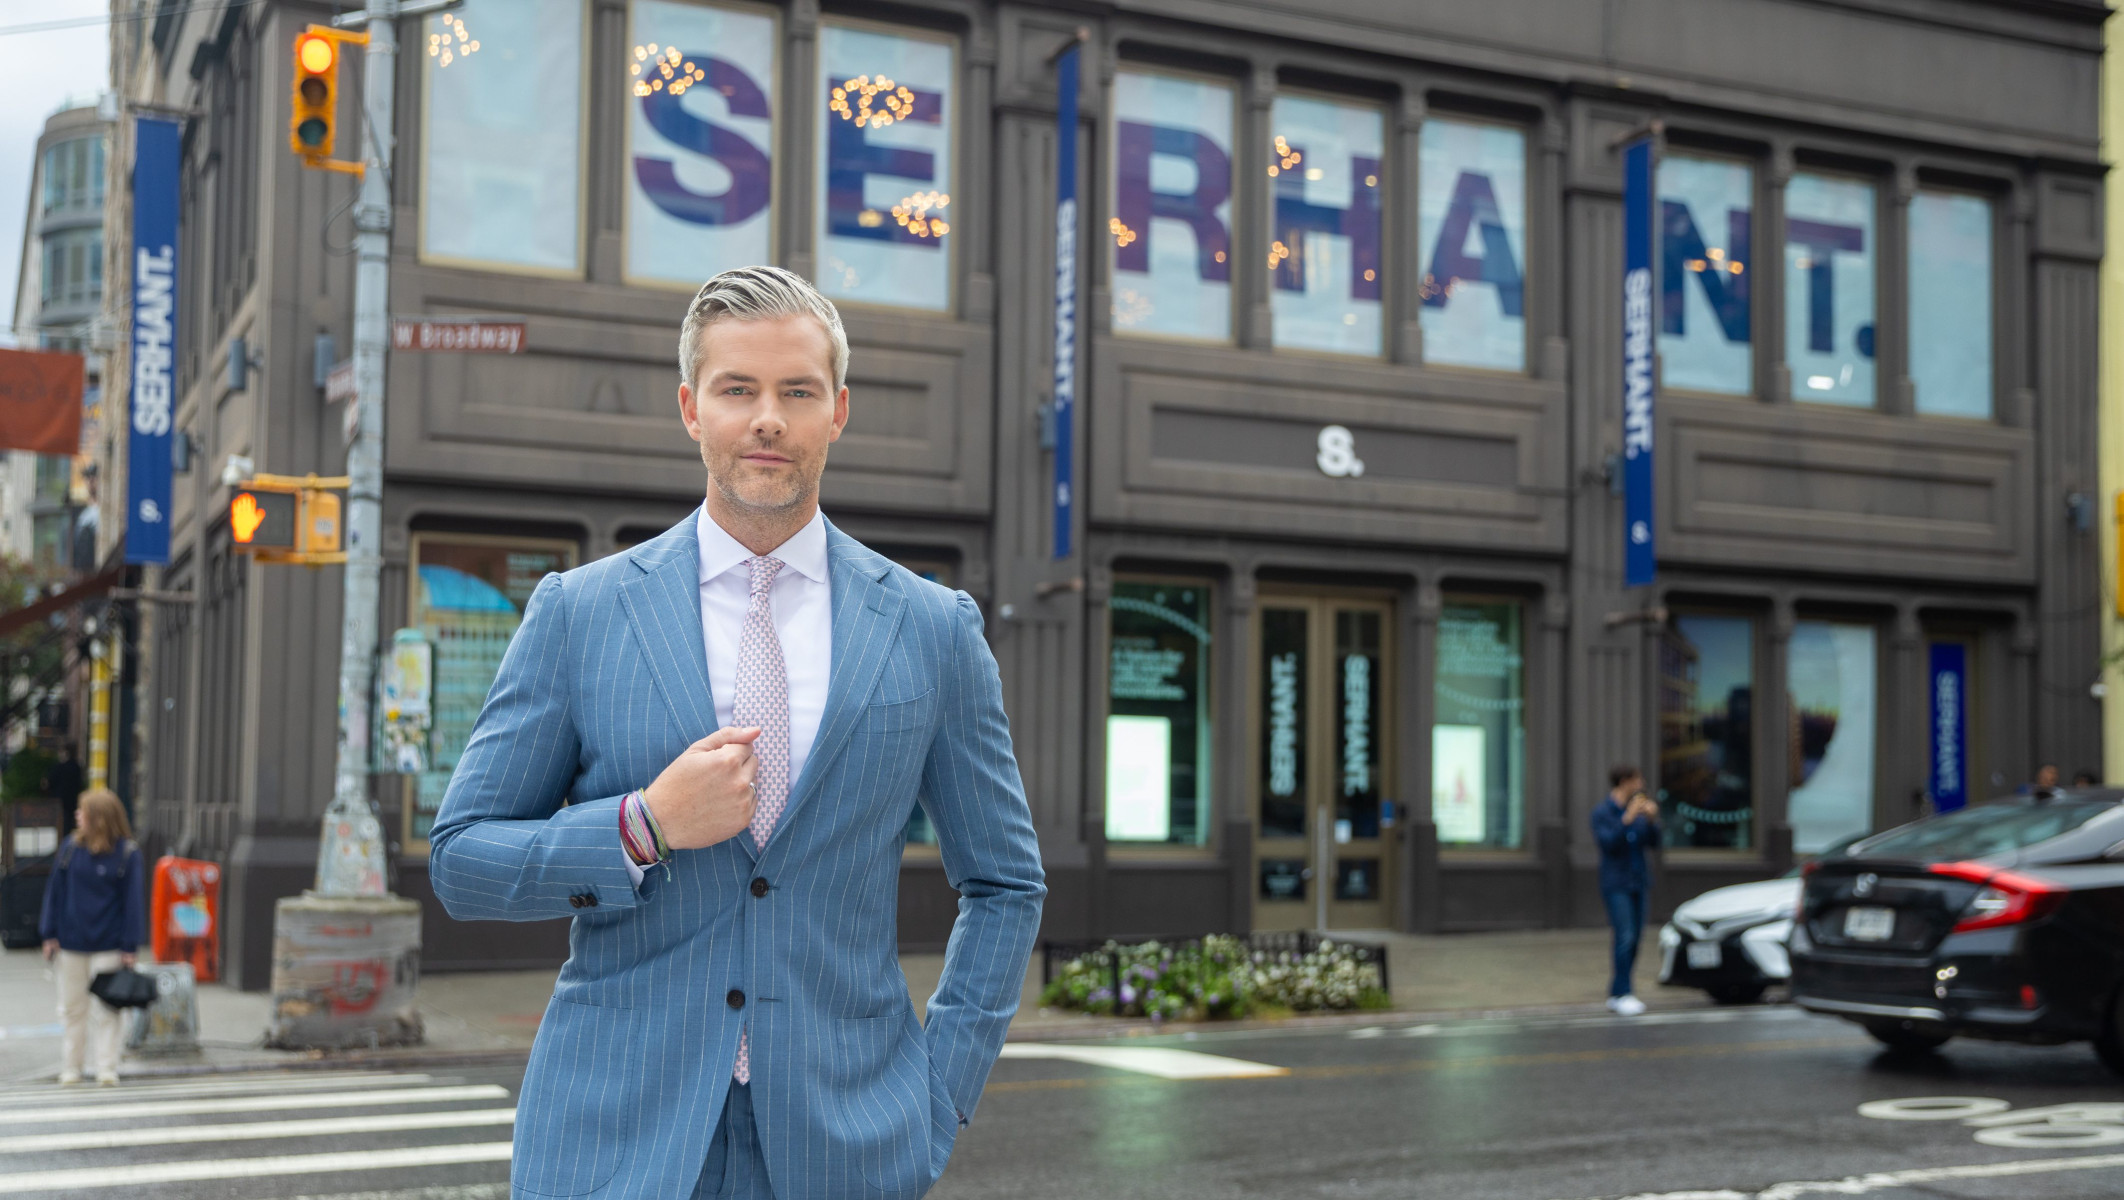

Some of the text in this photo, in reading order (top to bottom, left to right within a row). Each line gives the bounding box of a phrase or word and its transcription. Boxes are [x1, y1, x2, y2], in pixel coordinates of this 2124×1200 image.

[633, 54, 1876, 358] SERHANT.
[134, 244, 174, 436] SERHANT.
[393, 319, 521, 354] W Broadway
[1056, 198, 1077, 411] SERHANT.
[1625, 267, 1652, 460] SERHANT.
[1317, 425, 1365, 477] S.
[1270, 652, 1297, 796] SERHANT.
[1344, 653, 1370, 796] SERHANT.
